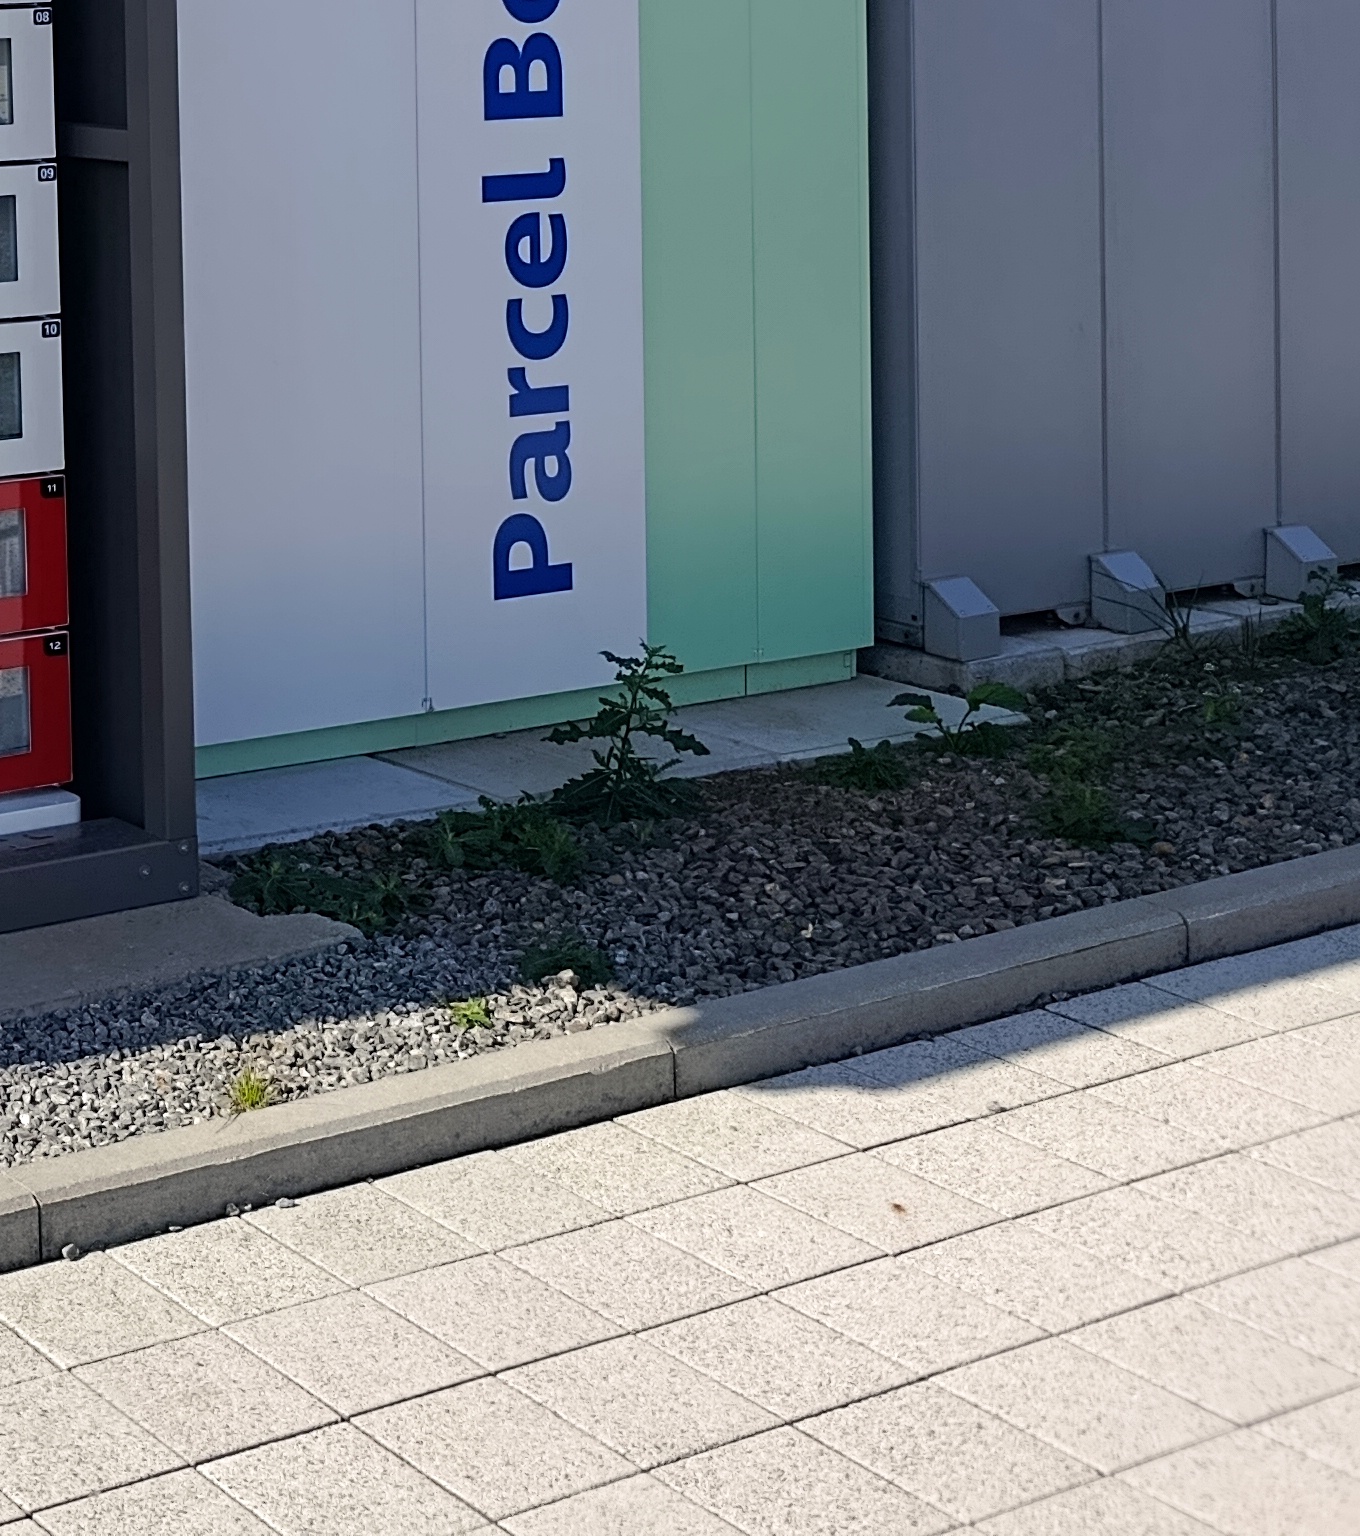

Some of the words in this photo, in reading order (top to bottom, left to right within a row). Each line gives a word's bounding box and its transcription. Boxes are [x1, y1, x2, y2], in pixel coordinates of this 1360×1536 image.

[35, 11, 49, 22] 08
[41, 167, 54, 179] 09
[44, 324, 57, 336] 10
[481, 157, 574, 600] Parcel
[47, 484, 57, 493] 11
[49, 642, 61, 651] 12
